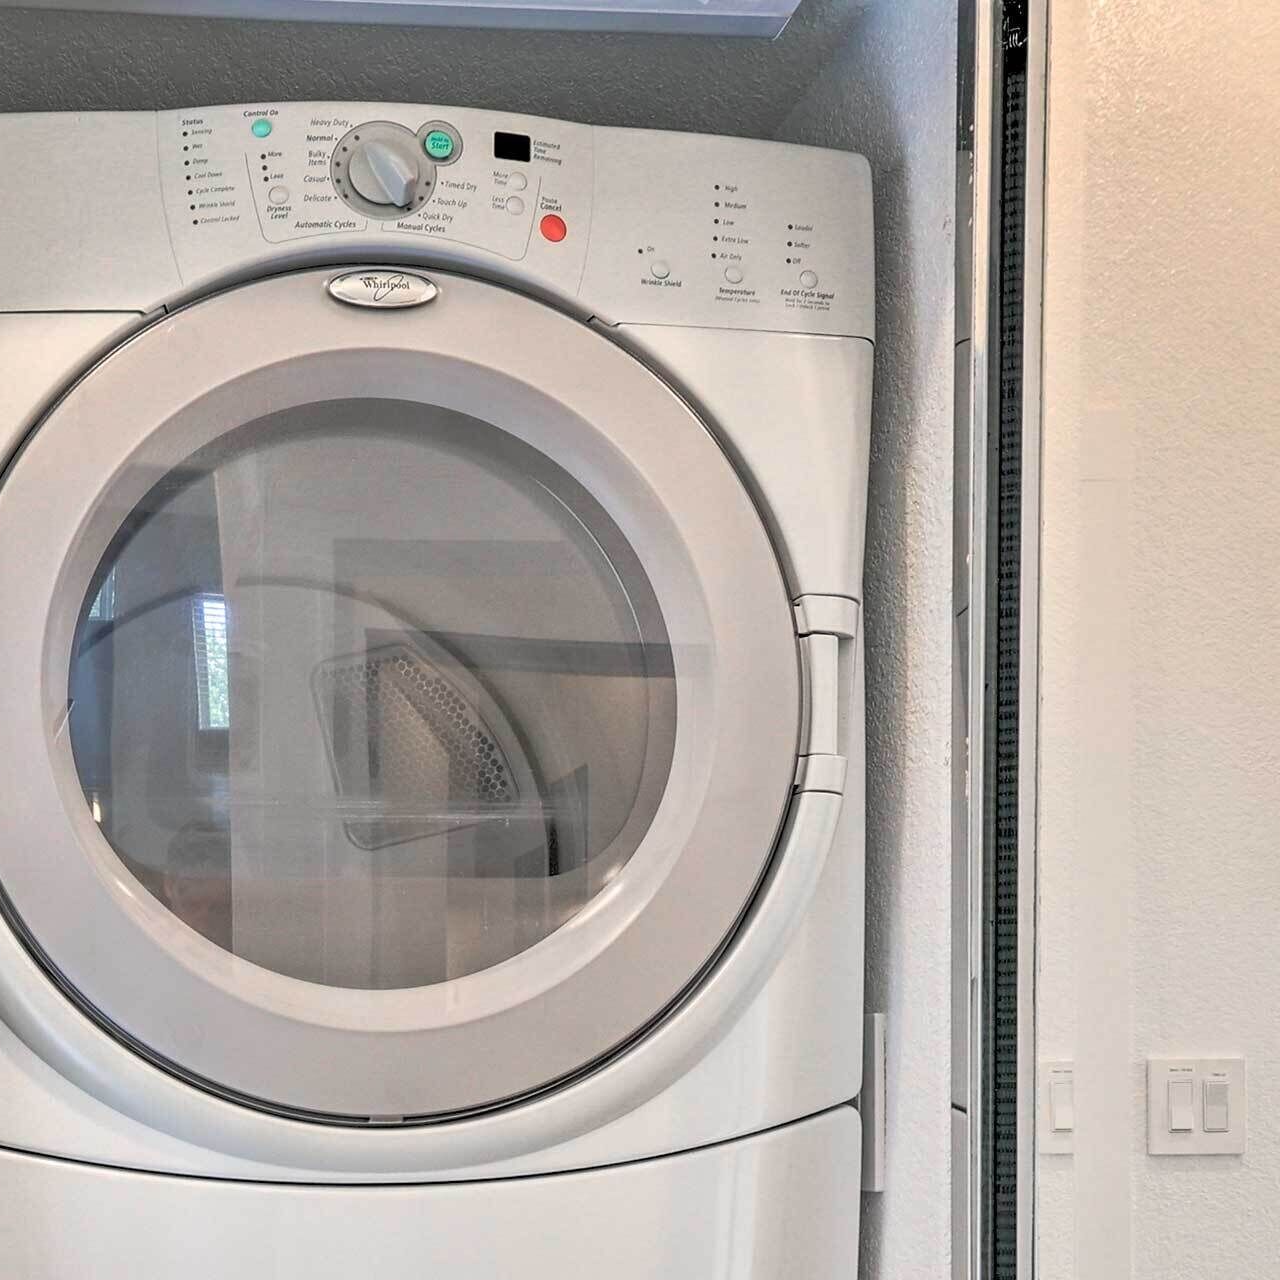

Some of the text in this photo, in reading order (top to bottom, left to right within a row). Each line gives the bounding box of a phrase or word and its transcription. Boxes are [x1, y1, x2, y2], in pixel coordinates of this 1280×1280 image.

[310, 118, 350, 128] Heavy Duty
[306, 134, 334, 142] Normal
[431, 141, 449, 150] Start
[308, 151, 325, 159] Bulky
[445, 181, 477, 192] Timed Dry
[303, 194, 332, 202] Delicate
[437, 199, 468, 208] Touch Up
[540, 203, 562, 212] Cancel
[267, 206, 291, 214] Dryness
[271, 212, 288, 220] Level
[422, 212, 440, 221] Quick
[295, 220, 357, 230] Automatic Cycles
[397, 221, 446, 233] Manual Cycles
[363, 279, 410, 291] Whirlpool
[719, 287, 755, 296] Temperature
[800, 291, 815, 299] Cycle
[816, 292, 835, 300] Signal
